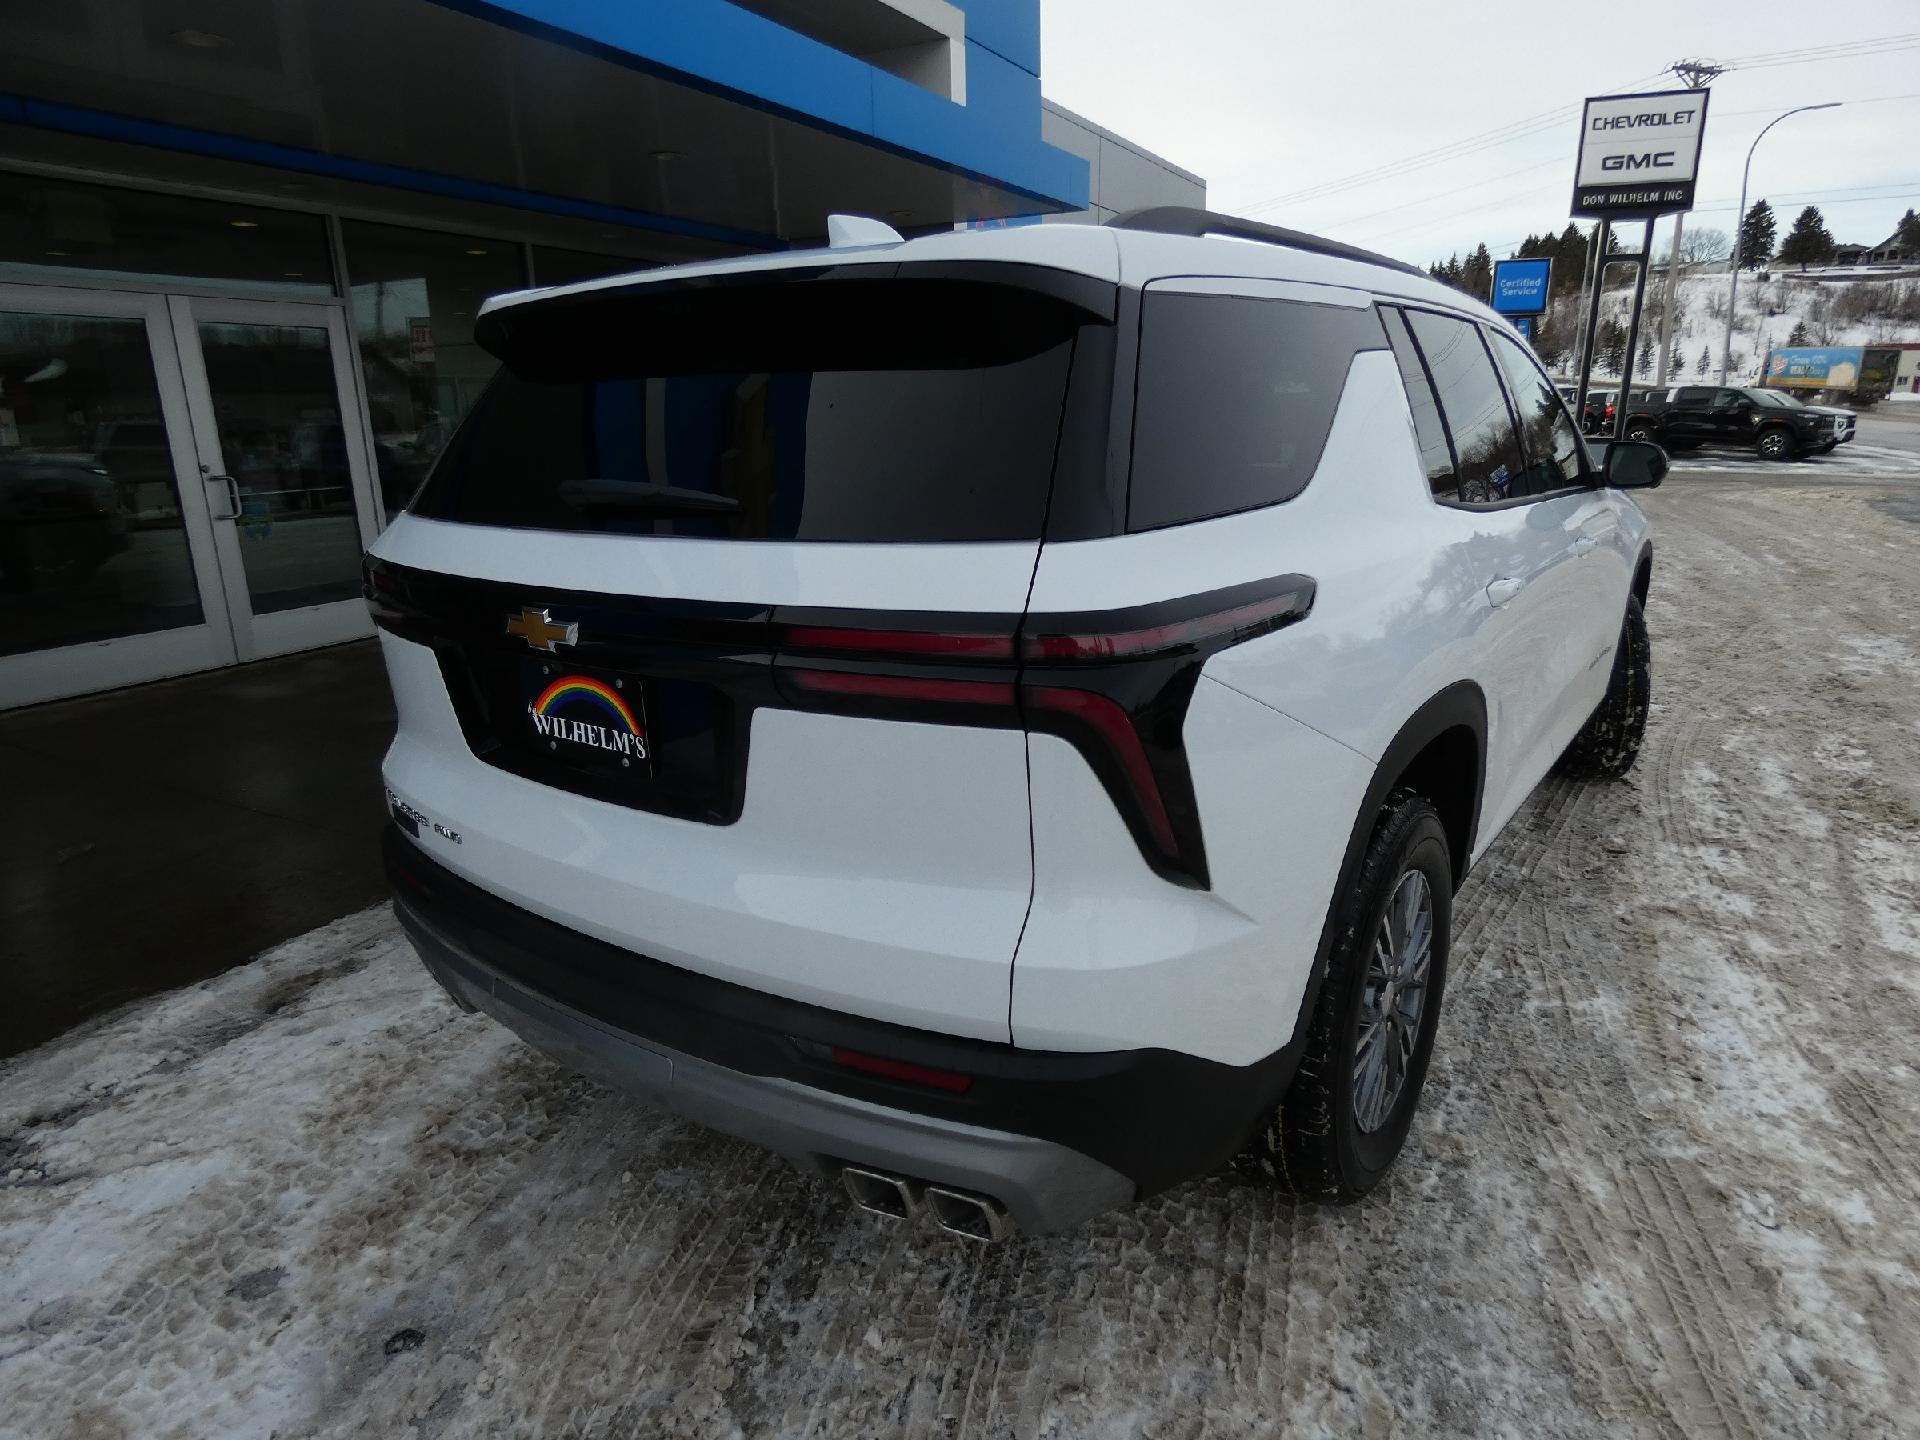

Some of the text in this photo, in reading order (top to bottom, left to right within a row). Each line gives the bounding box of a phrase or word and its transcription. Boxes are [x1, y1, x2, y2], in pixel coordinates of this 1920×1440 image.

[1592, 110, 1696, 131] CHEVROLET
[1601, 151, 1675, 171] GMC
[1582, 190, 1683, 206] DON WILHELM INC
[1500, 278, 1542, 288] Certified
[1502, 288, 1538, 296] Service
[528, 703, 646, 759] WILHELM'S
